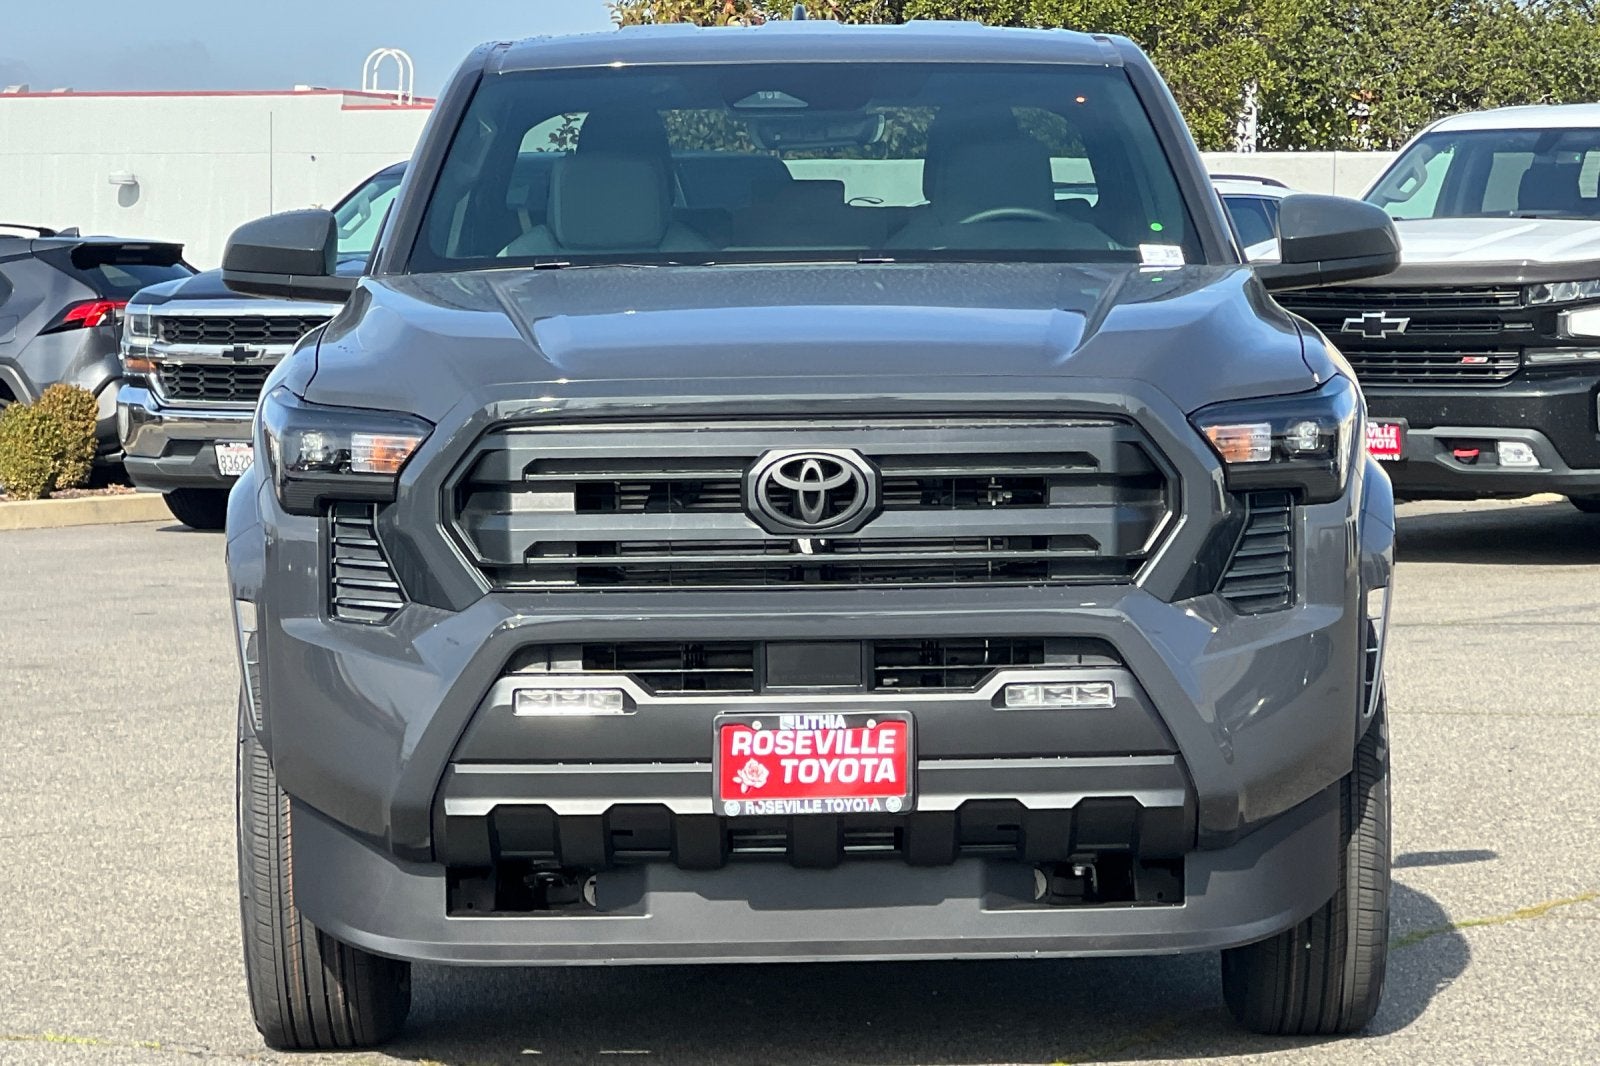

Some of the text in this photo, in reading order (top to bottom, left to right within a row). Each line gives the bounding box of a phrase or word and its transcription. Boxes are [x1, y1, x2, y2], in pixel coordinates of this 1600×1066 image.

[1366, 427, 1397, 438] VILLE
[795, 714, 847, 730] LITHIA
[731, 729, 897, 756] ROSEVILLE
[780, 757, 896, 784] TOYOTA
[745, 797, 881, 815] ROSEVILLE TOYOTA
